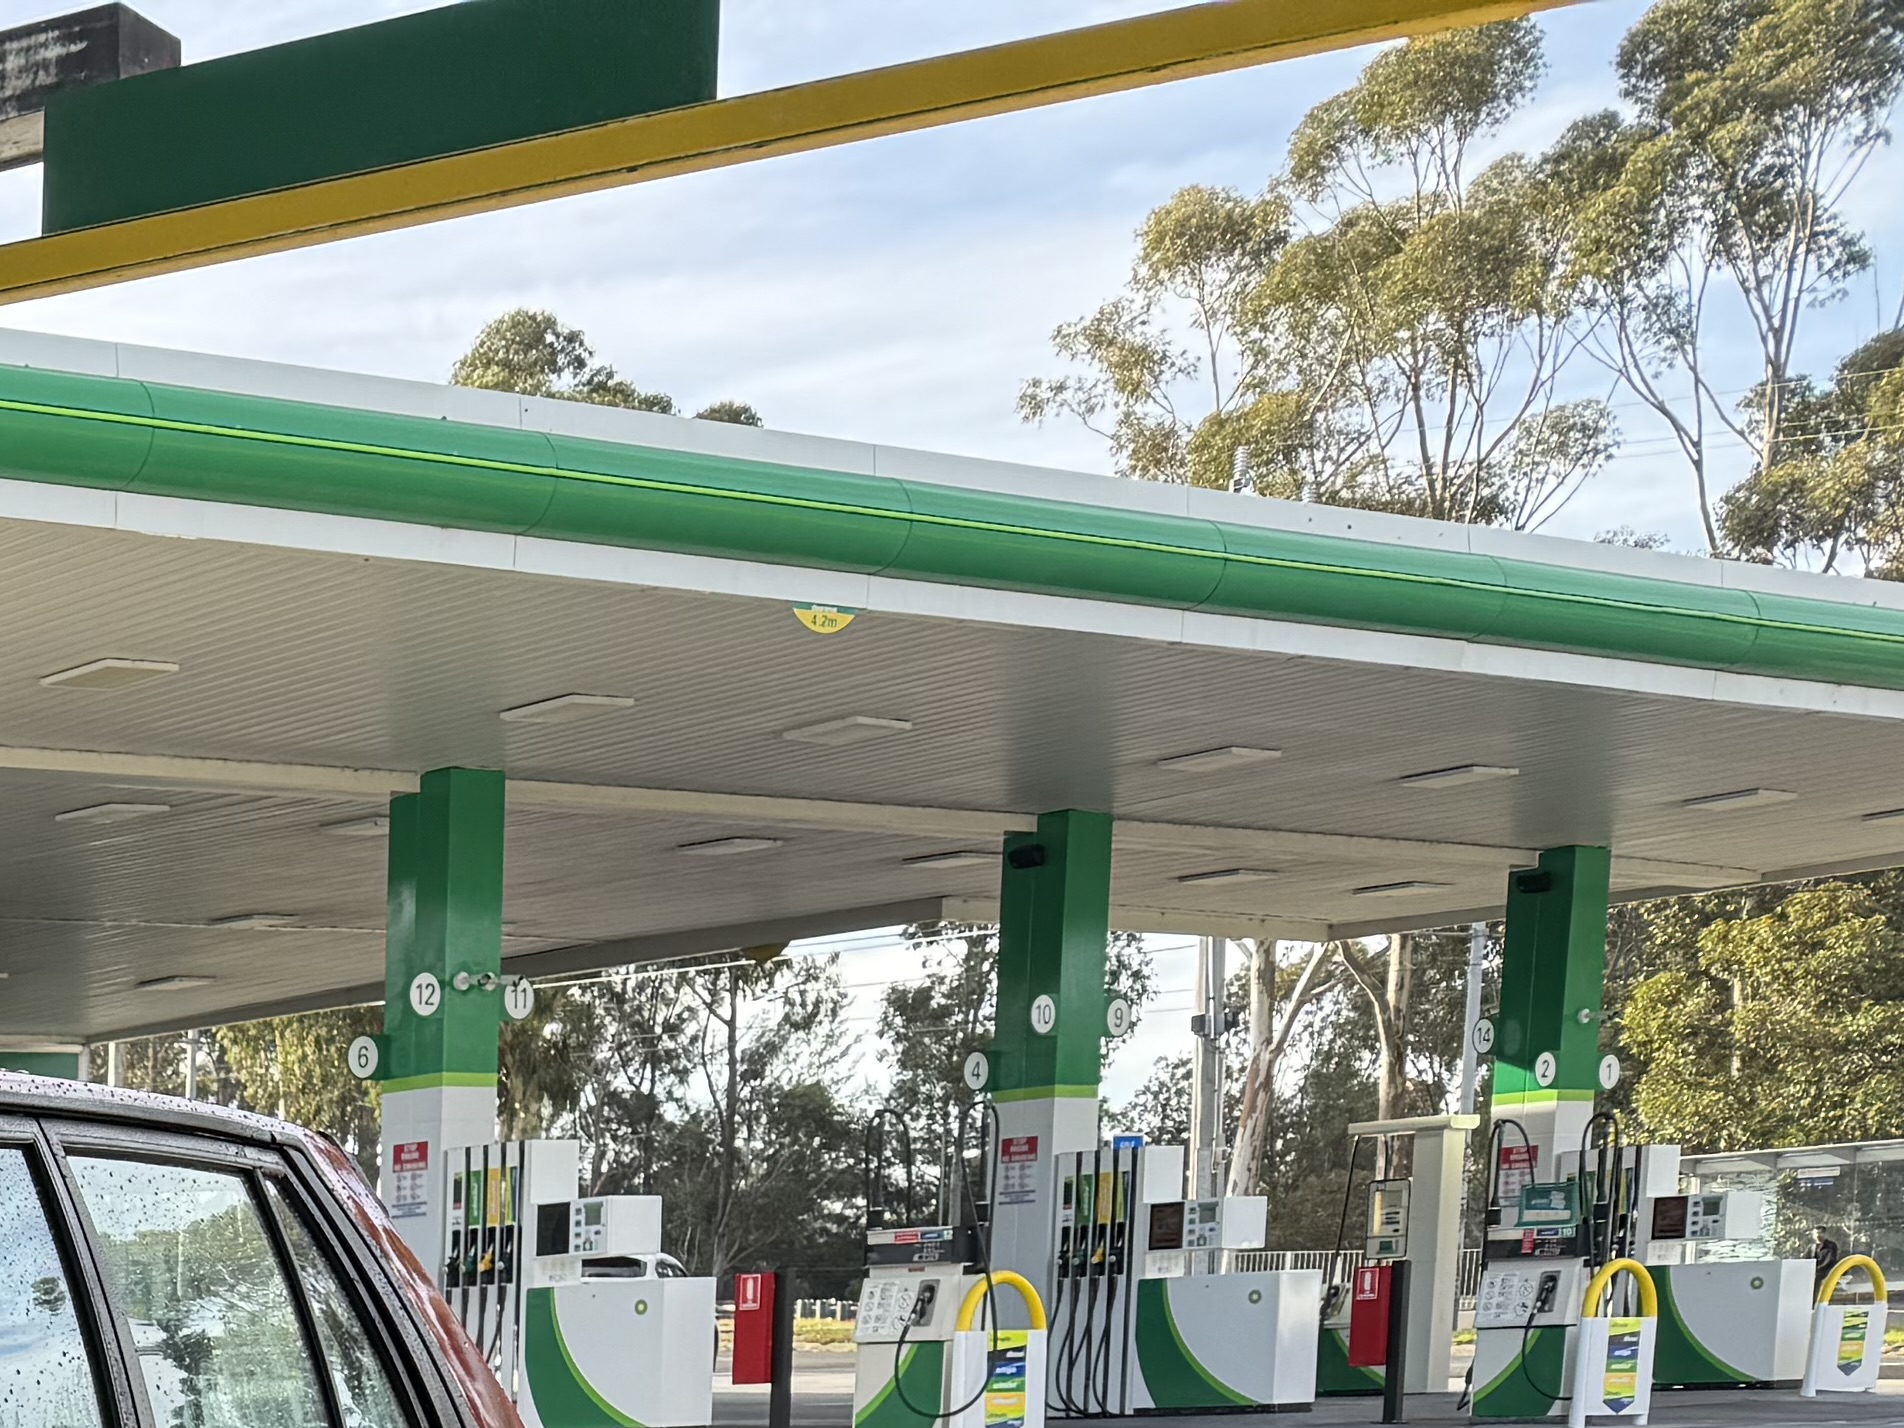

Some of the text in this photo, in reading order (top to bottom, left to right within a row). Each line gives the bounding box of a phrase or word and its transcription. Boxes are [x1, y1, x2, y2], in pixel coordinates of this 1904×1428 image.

[811, 614, 838, 628] 4.2m
[415, 982, 435, 1006] 12
[511, 987, 527, 1010] 11
[1035, 1004, 1051, 1025] 10
[1114, 1007, 1123, 1028] 9
[1476, 1027, 1491, 1045] 14
[357, 1046, 369, 1069] 6
[971, 1061, 981, 1081] 4
[1541, 1060, 1550, 1079] 2
[1606, 1063, 1612, 1081] 1
